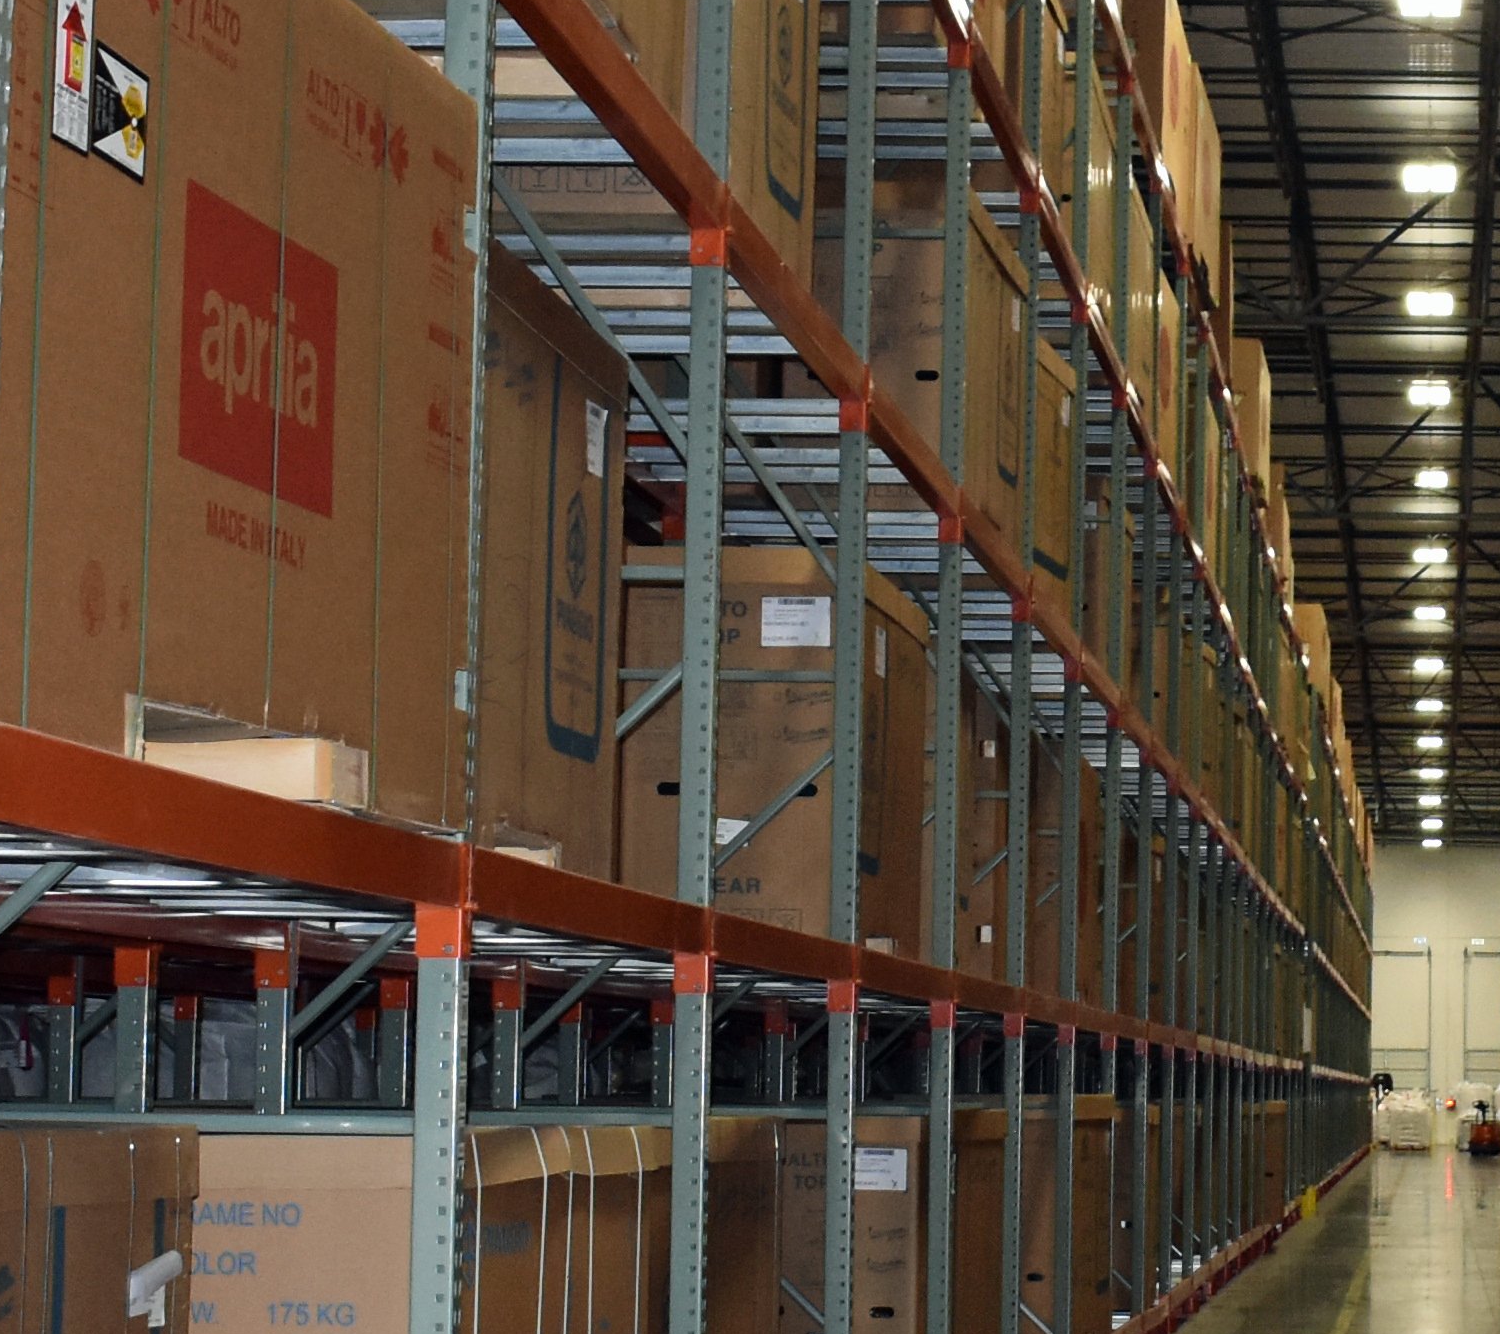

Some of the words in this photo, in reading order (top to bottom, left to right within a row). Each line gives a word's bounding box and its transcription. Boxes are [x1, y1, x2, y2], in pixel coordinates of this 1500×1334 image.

[200, 288, 318, 428] aprilia
[206, 500, 248, 550] MADE
[250, 517, 267, 555] IN
[268, 527, 307, 570] ITALY
[262, 1203, 302, 1227] NO
[267, 1302, 310, 1326] 175
[316, 1303, 356, 1326] KG
